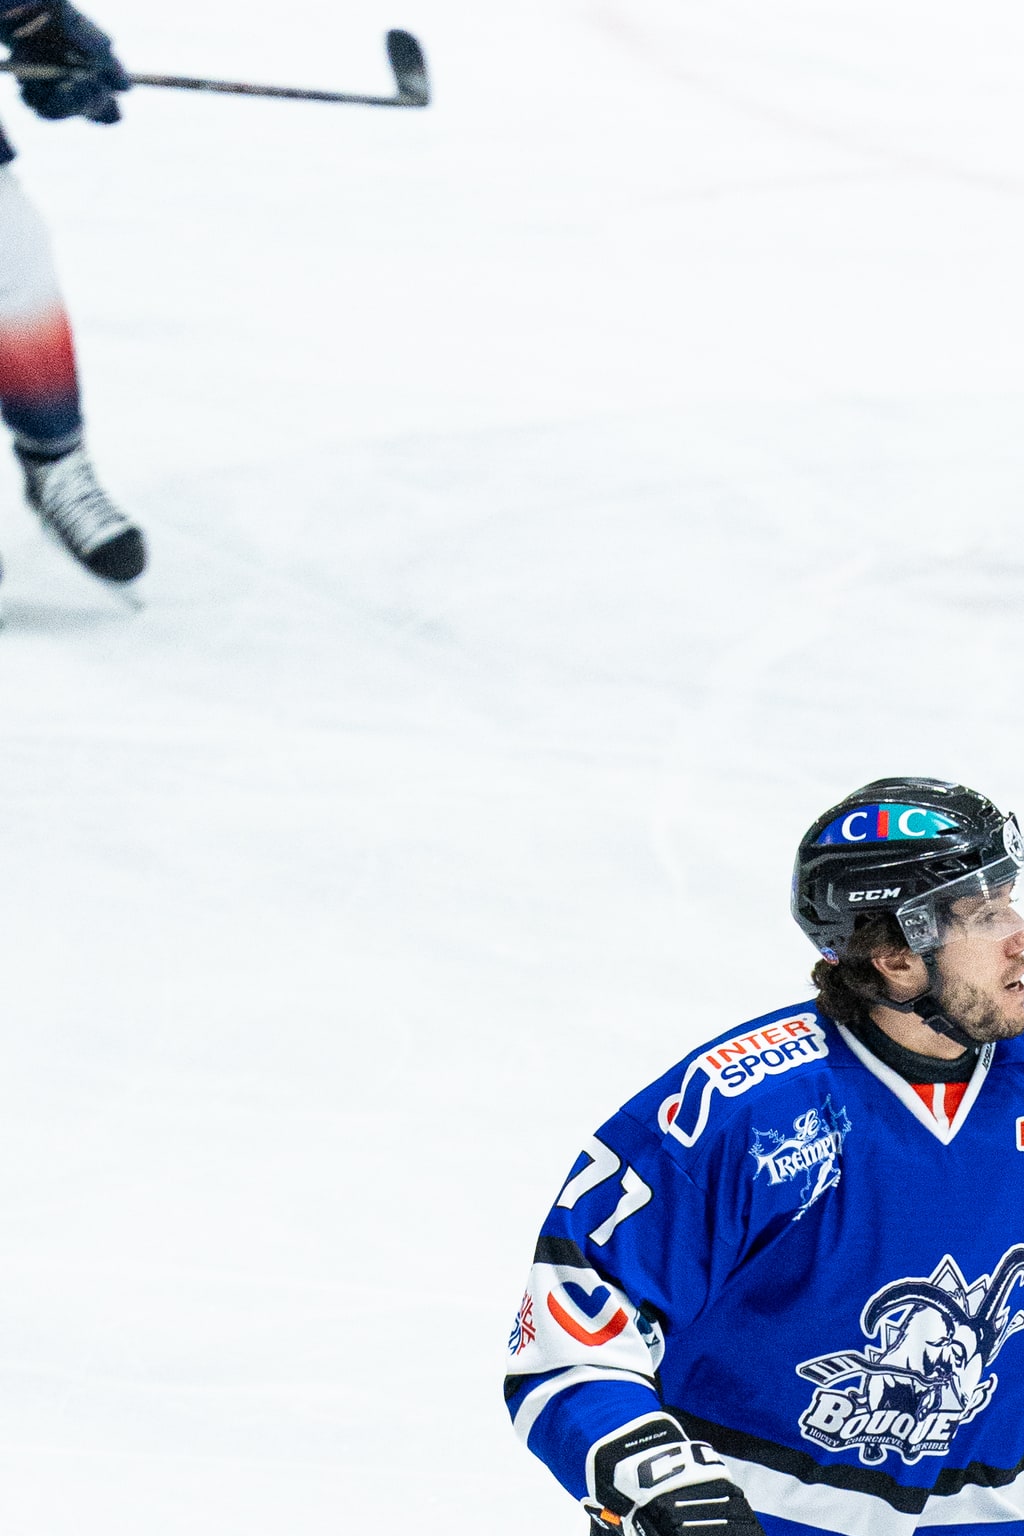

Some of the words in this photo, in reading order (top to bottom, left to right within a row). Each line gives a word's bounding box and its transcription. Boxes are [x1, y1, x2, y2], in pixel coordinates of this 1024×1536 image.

[841, 808, 927, 841] CIC
[849, 887, 901, 902] CCM
[706, 1020, 812, 1070] INTER
[720, 1033, 820, 1088] SPORT
[556, 1134, 653, 1247] 77
